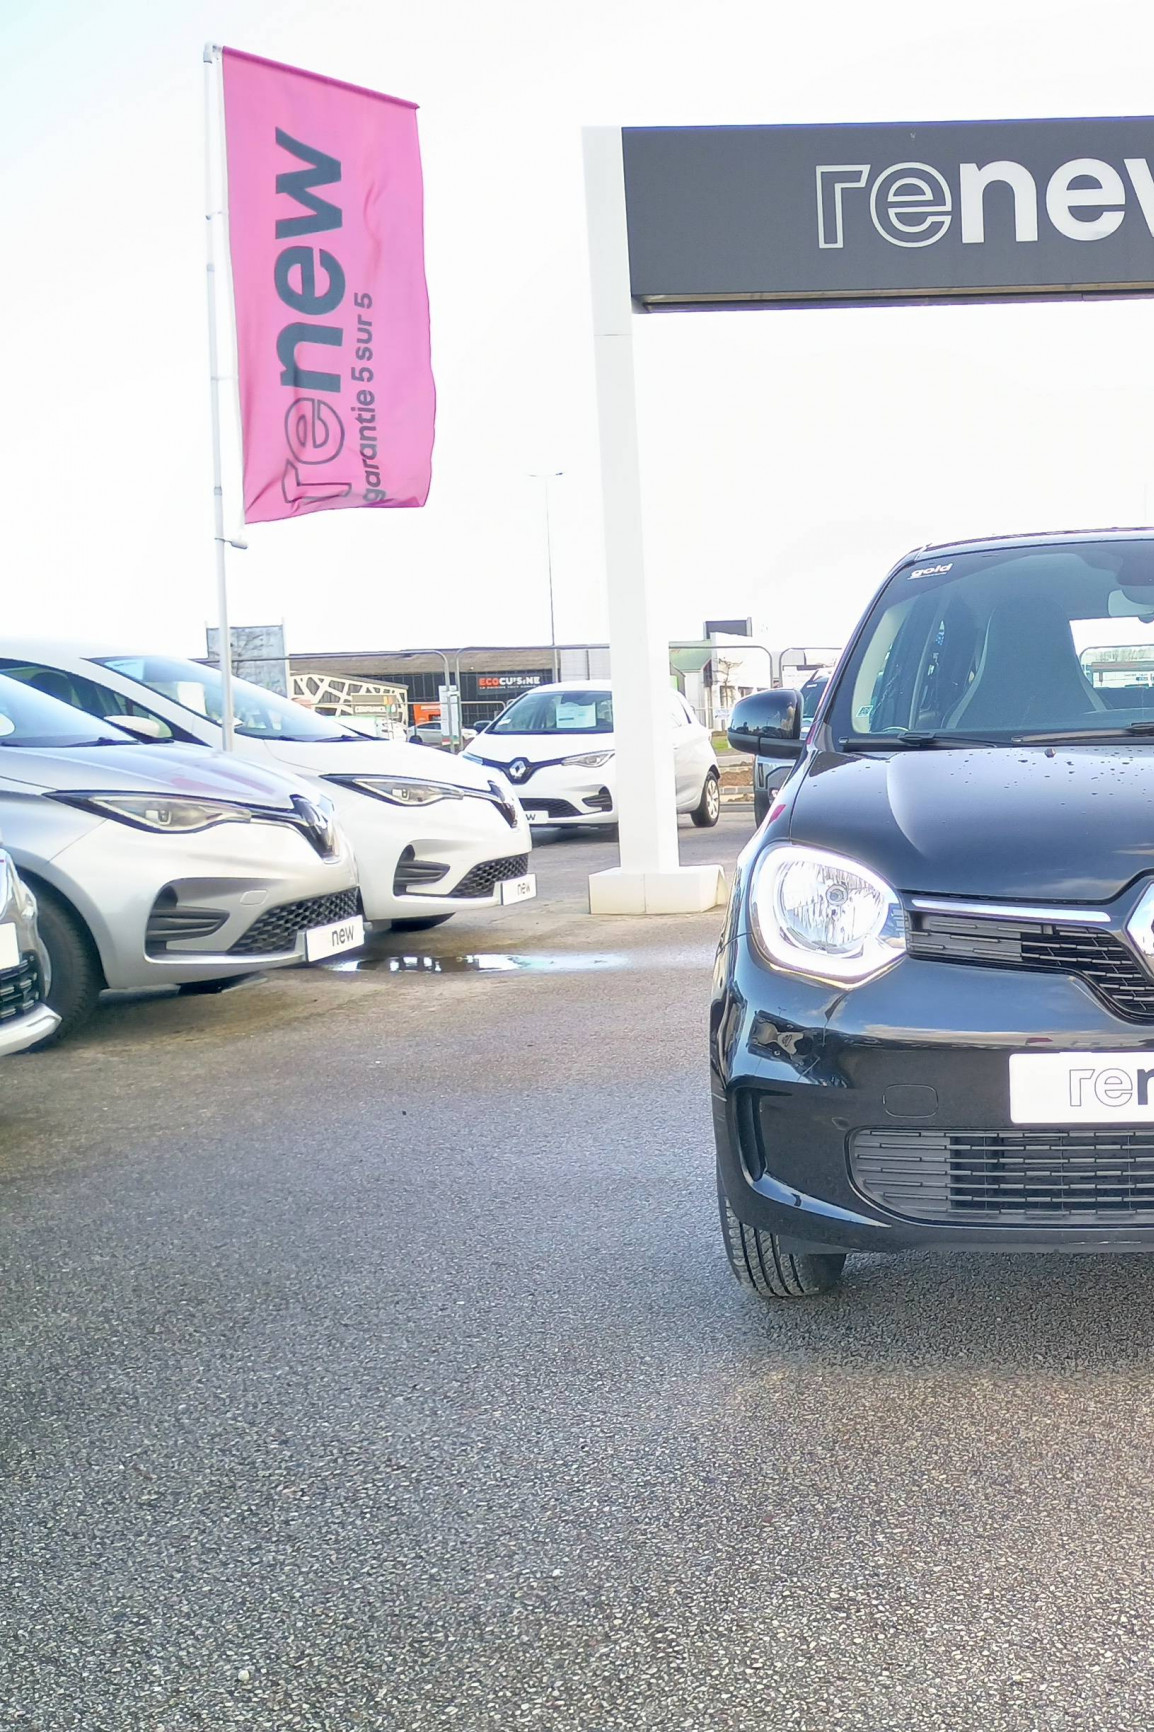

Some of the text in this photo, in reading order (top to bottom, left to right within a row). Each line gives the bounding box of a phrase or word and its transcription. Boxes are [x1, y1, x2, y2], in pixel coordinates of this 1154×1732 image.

[274, 126, 351, 506] renew
[350, 292, 386, 501] garantie 5 sur 5
[911, 563, 953, 579] gold
